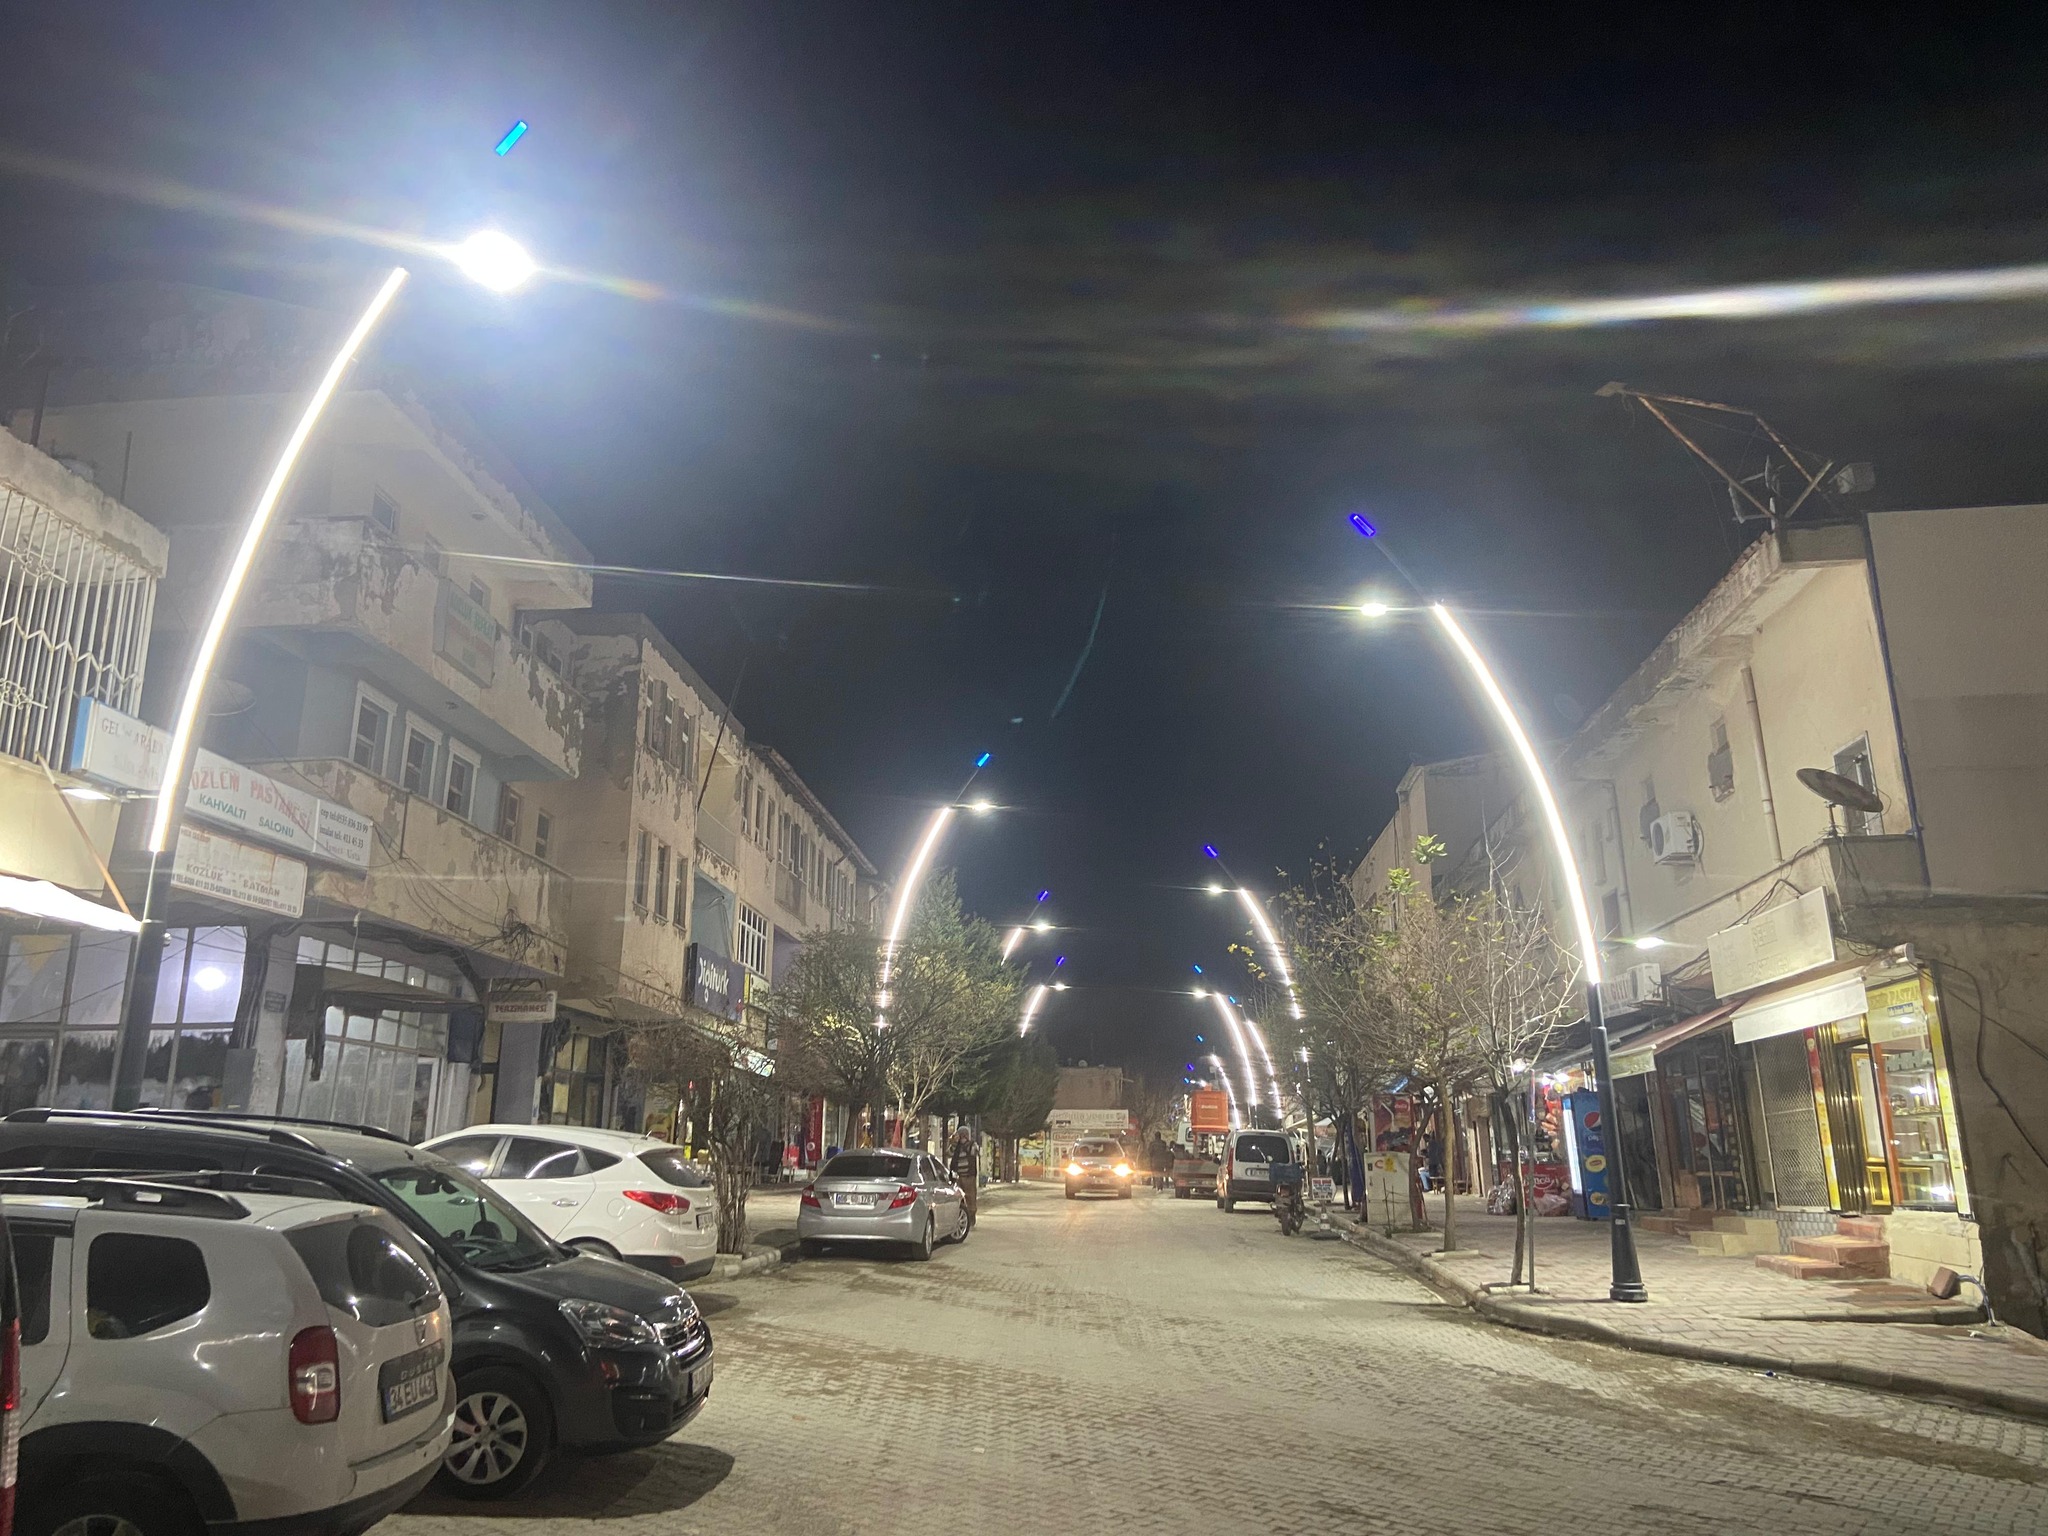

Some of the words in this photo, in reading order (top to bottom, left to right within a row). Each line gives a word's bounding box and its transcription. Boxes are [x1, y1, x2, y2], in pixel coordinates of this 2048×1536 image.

[199, 794, 247, 820] KAHVALTI
[258, 816, 295, 838] SALONU
[250, 779, 310, 831] PASTANESİ
[186, 863, 223, 882] KOZLUK
[243, 879, 280, 897] BATMAN
